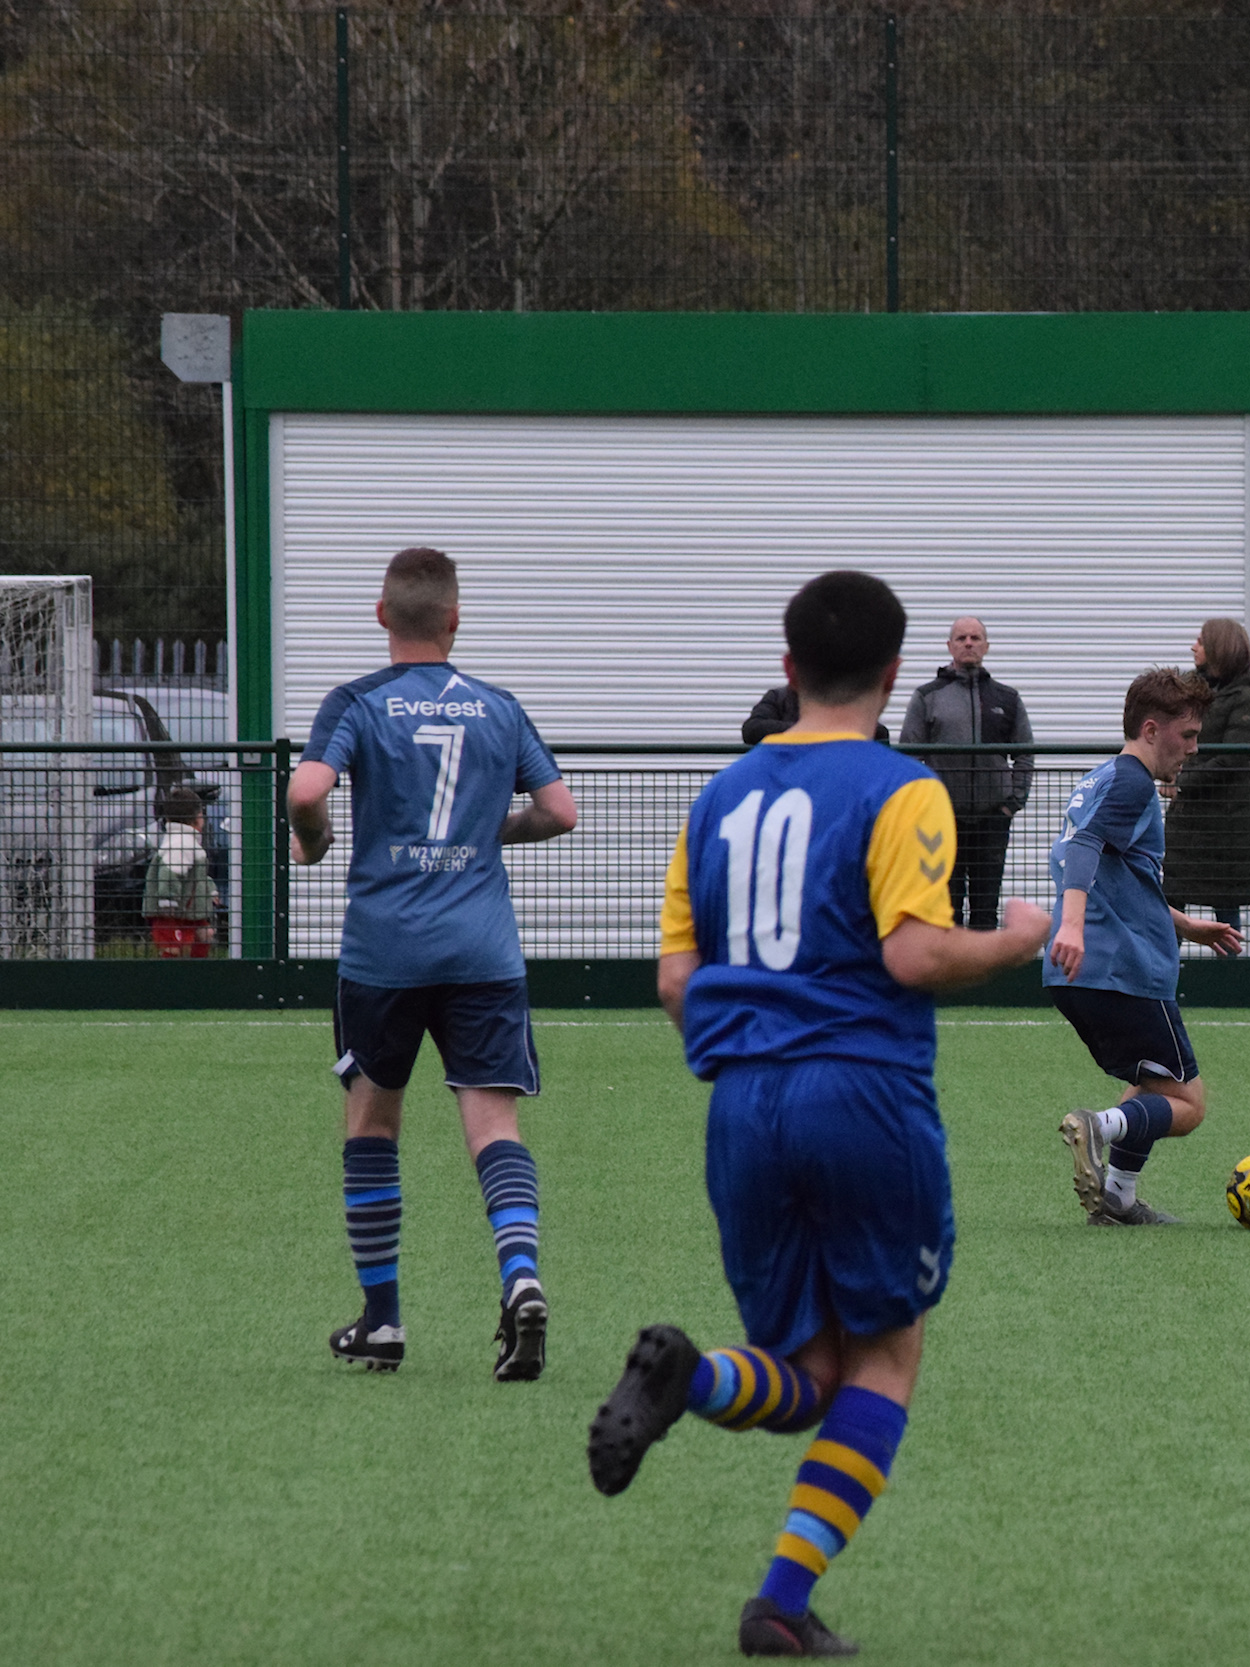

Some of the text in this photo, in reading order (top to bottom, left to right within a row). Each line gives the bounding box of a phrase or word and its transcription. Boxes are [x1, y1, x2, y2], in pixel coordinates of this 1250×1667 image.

[386, 697, 486, 717] Everest
[413, 724, 465, 840] 7
[408, 845, 428, 859] W2
[420, 859, 467, 872] SYSTEMS
[719, 788, 812, 971] 10
